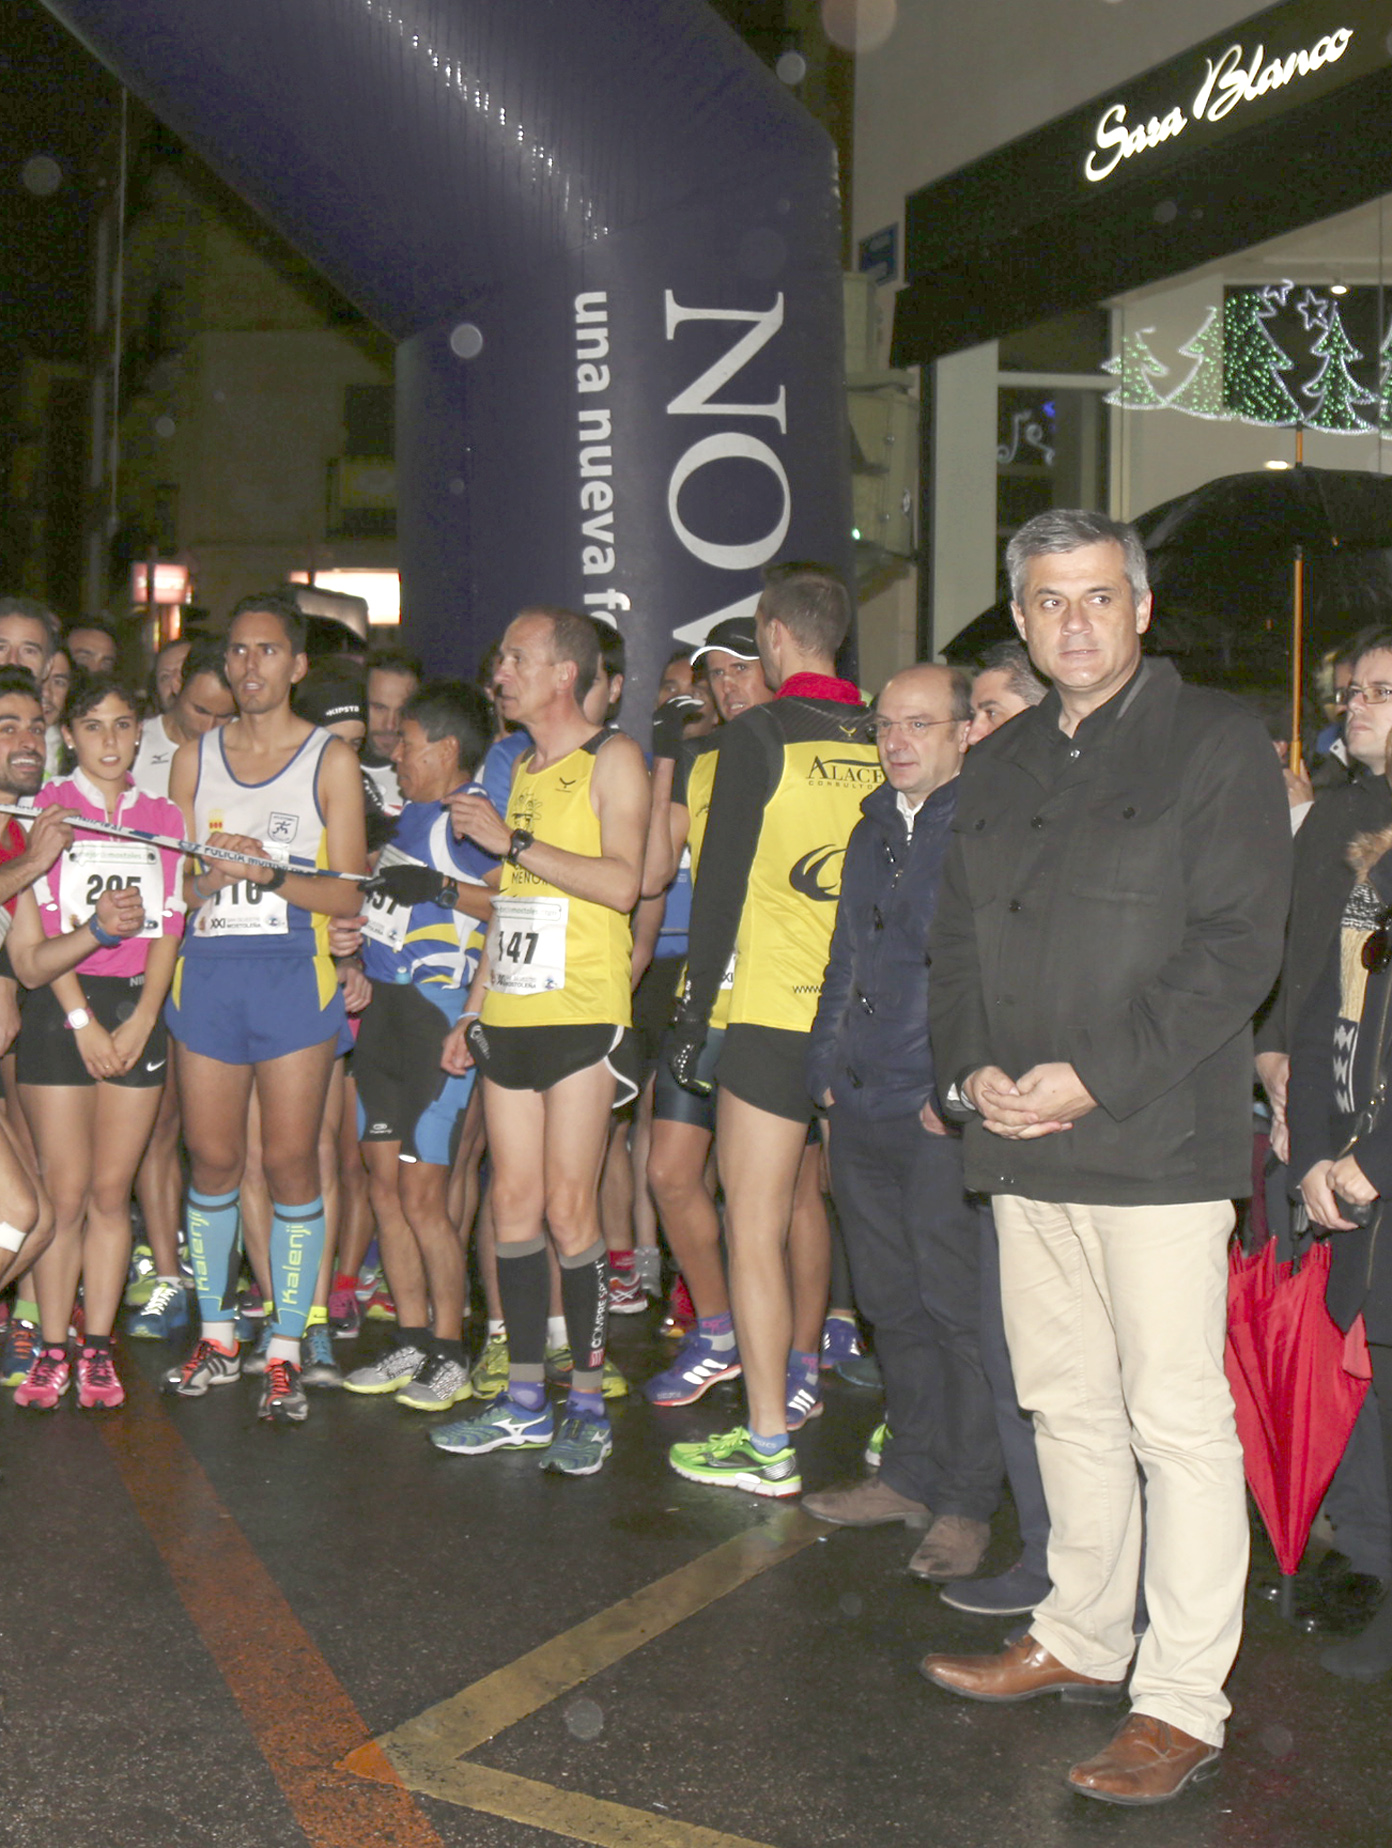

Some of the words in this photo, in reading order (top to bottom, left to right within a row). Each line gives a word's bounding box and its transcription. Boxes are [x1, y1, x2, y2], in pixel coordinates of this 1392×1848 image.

[1085, 104, 1188, 182] Sara
[1192, 27, 1354, 122] Blanco
[574, 291, 610, 393] una
[578, 409, 616, 575] nueva
[282, 1224, 311, 1305] kalenji
